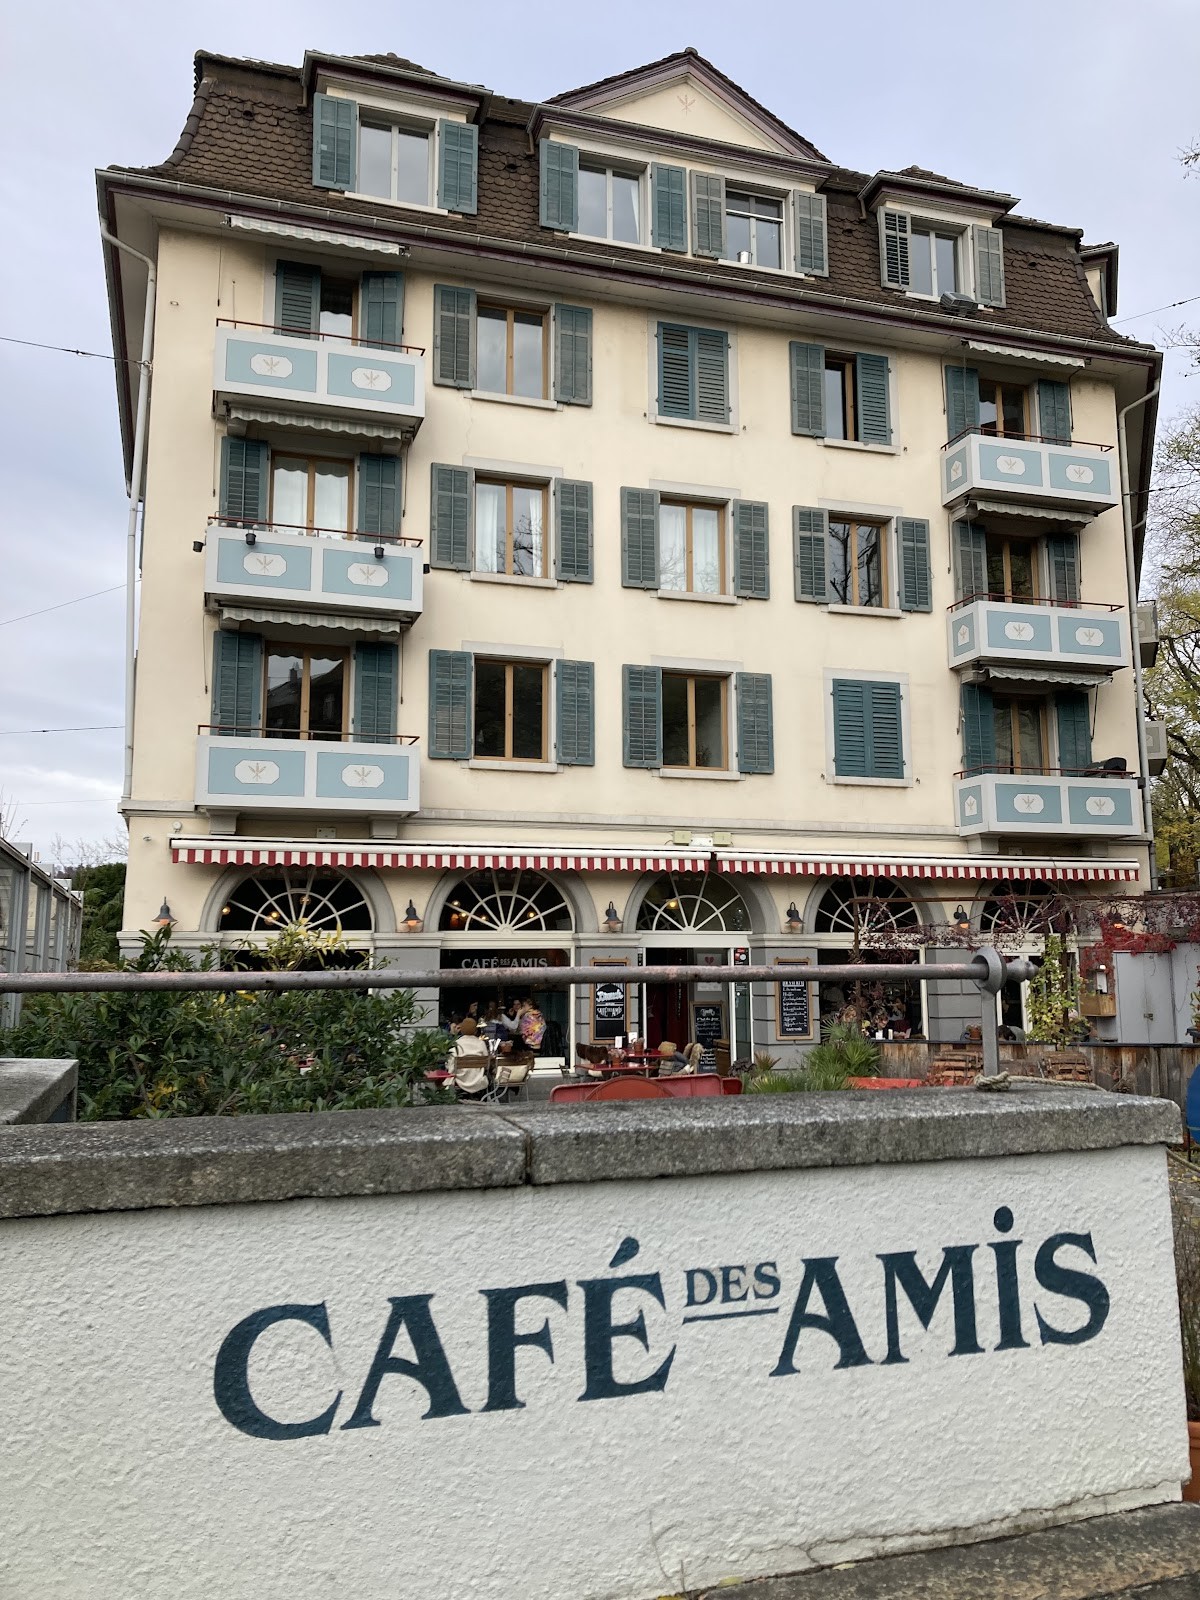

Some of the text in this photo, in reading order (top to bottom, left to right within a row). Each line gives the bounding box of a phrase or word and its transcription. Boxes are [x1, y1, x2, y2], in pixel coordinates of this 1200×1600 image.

[461, 957, 499, 969] CAFÉ
[511, 958, 548, 968] AMIS
[213, 1237, 677, 1441] CAFÉ
[684, 1262, 781, 1308] DES
